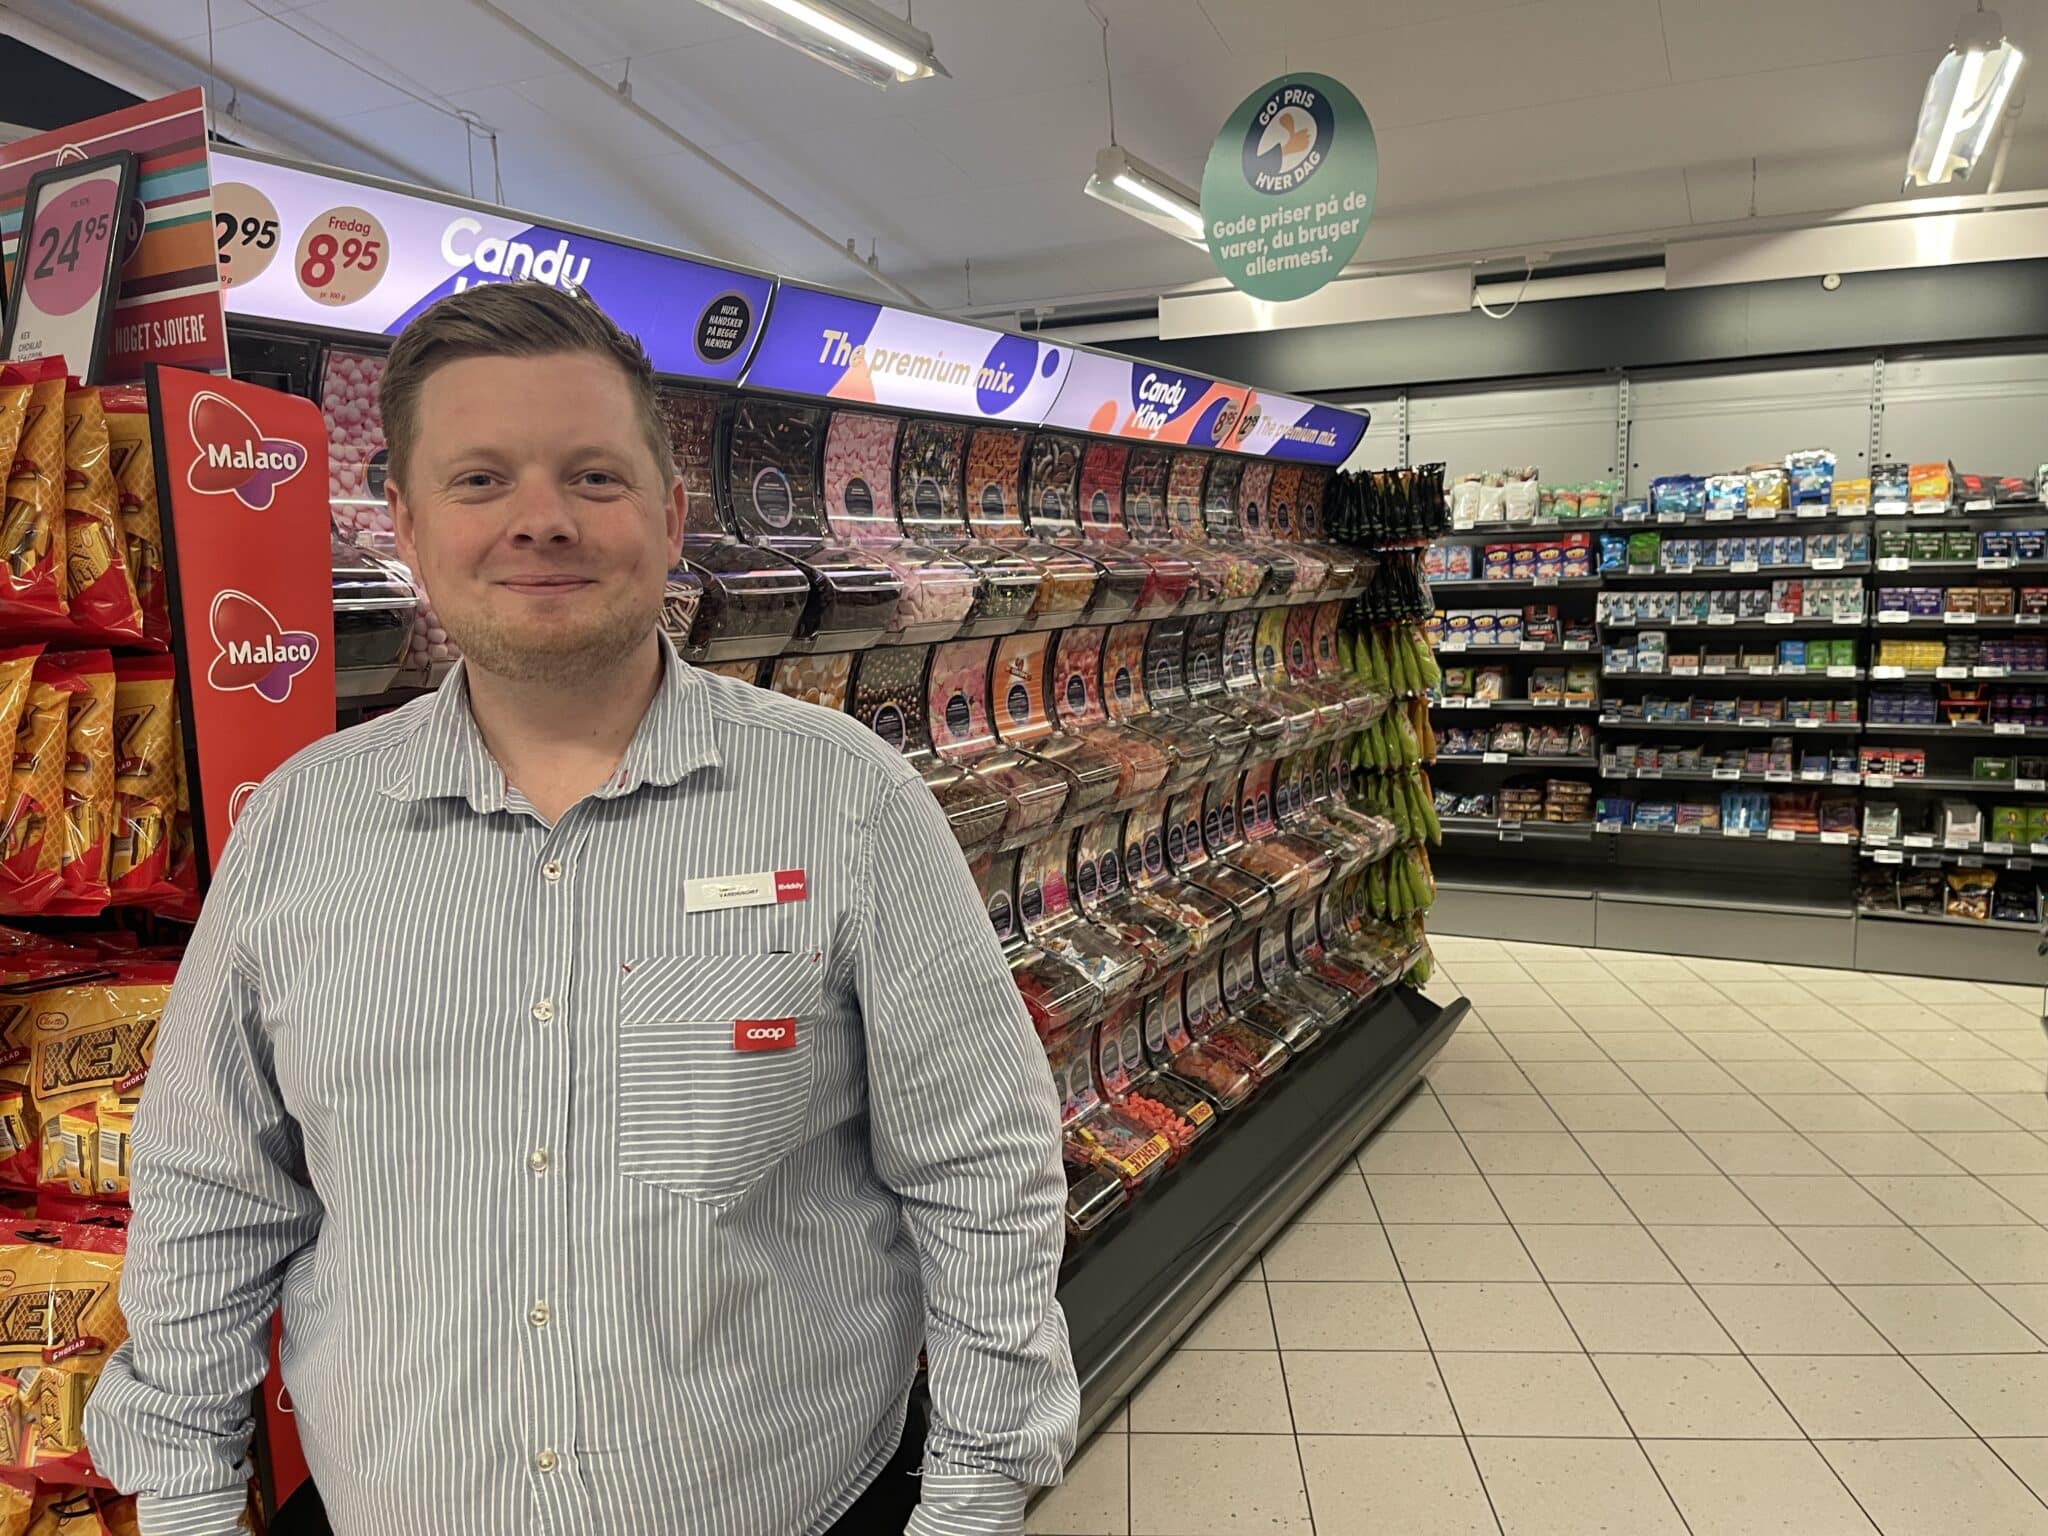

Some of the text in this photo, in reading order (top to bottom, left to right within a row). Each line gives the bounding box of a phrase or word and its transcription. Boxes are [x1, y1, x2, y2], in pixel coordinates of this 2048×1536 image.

[1284, 89, 1315, 108] PRIS
[1255, 151, 1321, 190] HVER DAG
[328, 216, 371, 236] Fredag
[1212, 191, 1367, 239] Gode priser på de
[1220, 217, 1360, 260] varer, du bruger
[441, 217, 591, 298] Candy
[1245, 245, 1333, 277] allermest.
[709, 315, 744, 328] HANDSKER
[721, 305, 739, 316] HUSK
[115, 313, 207, 354] NOGET SJOVERE
[704, 338, 733, 350] HÆNDER
[706, 326, 738, 339] PÅ BEGGE
[818, 329, 1016, 394] The premium mix.
[1138, 372, 1187, 414] Candy
[1131, 403, 1168, 439] King
[1259, 415, 1275, 436] The
[1274, 422, 1319, 444] premium
[207, 439, 298, 472] Malaco
[228, 634, 312, 666] Malaco
[43, 1020, 157, 1092] KEX
[122, 1070, 149, 1089] CHOKLA
